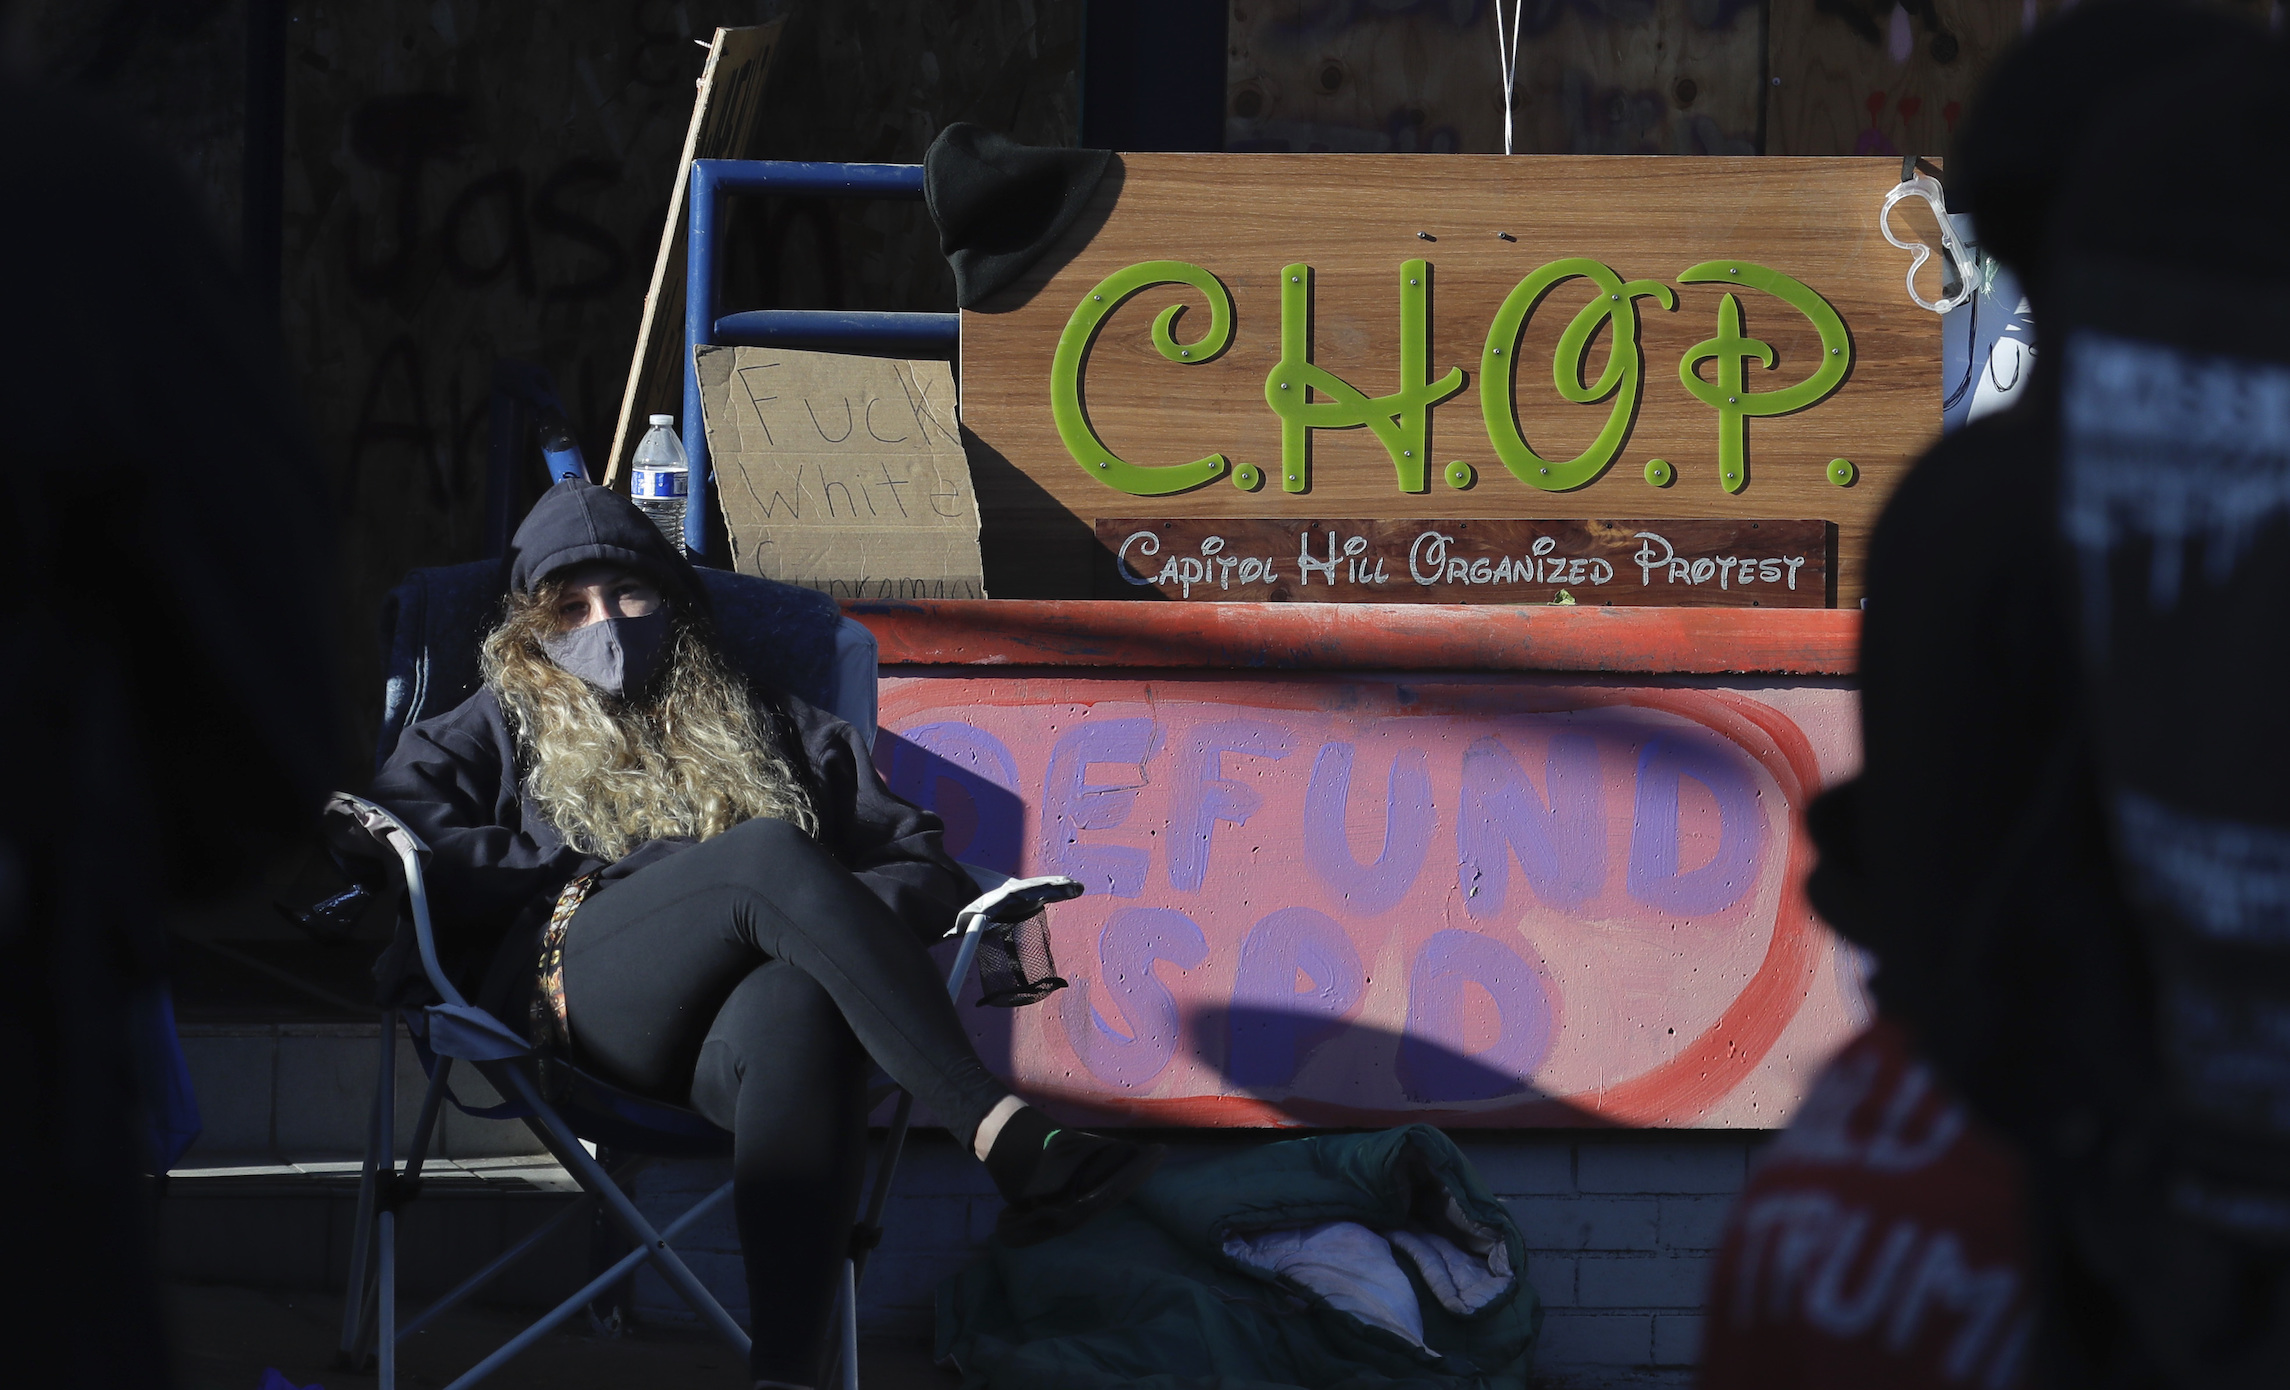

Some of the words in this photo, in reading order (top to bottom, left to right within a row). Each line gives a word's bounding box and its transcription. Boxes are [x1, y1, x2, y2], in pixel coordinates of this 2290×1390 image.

[345, 94, 846, 308] Jasn
[1051, 257, 1854, 494] C.H.O.P.
[738, 460, 963, 519] White
[891, 715, 1768, 918] DEFUND
[1058, 906, 1558, 1103] SPD
[1730, 1187, 2036, 1390] TRUM
